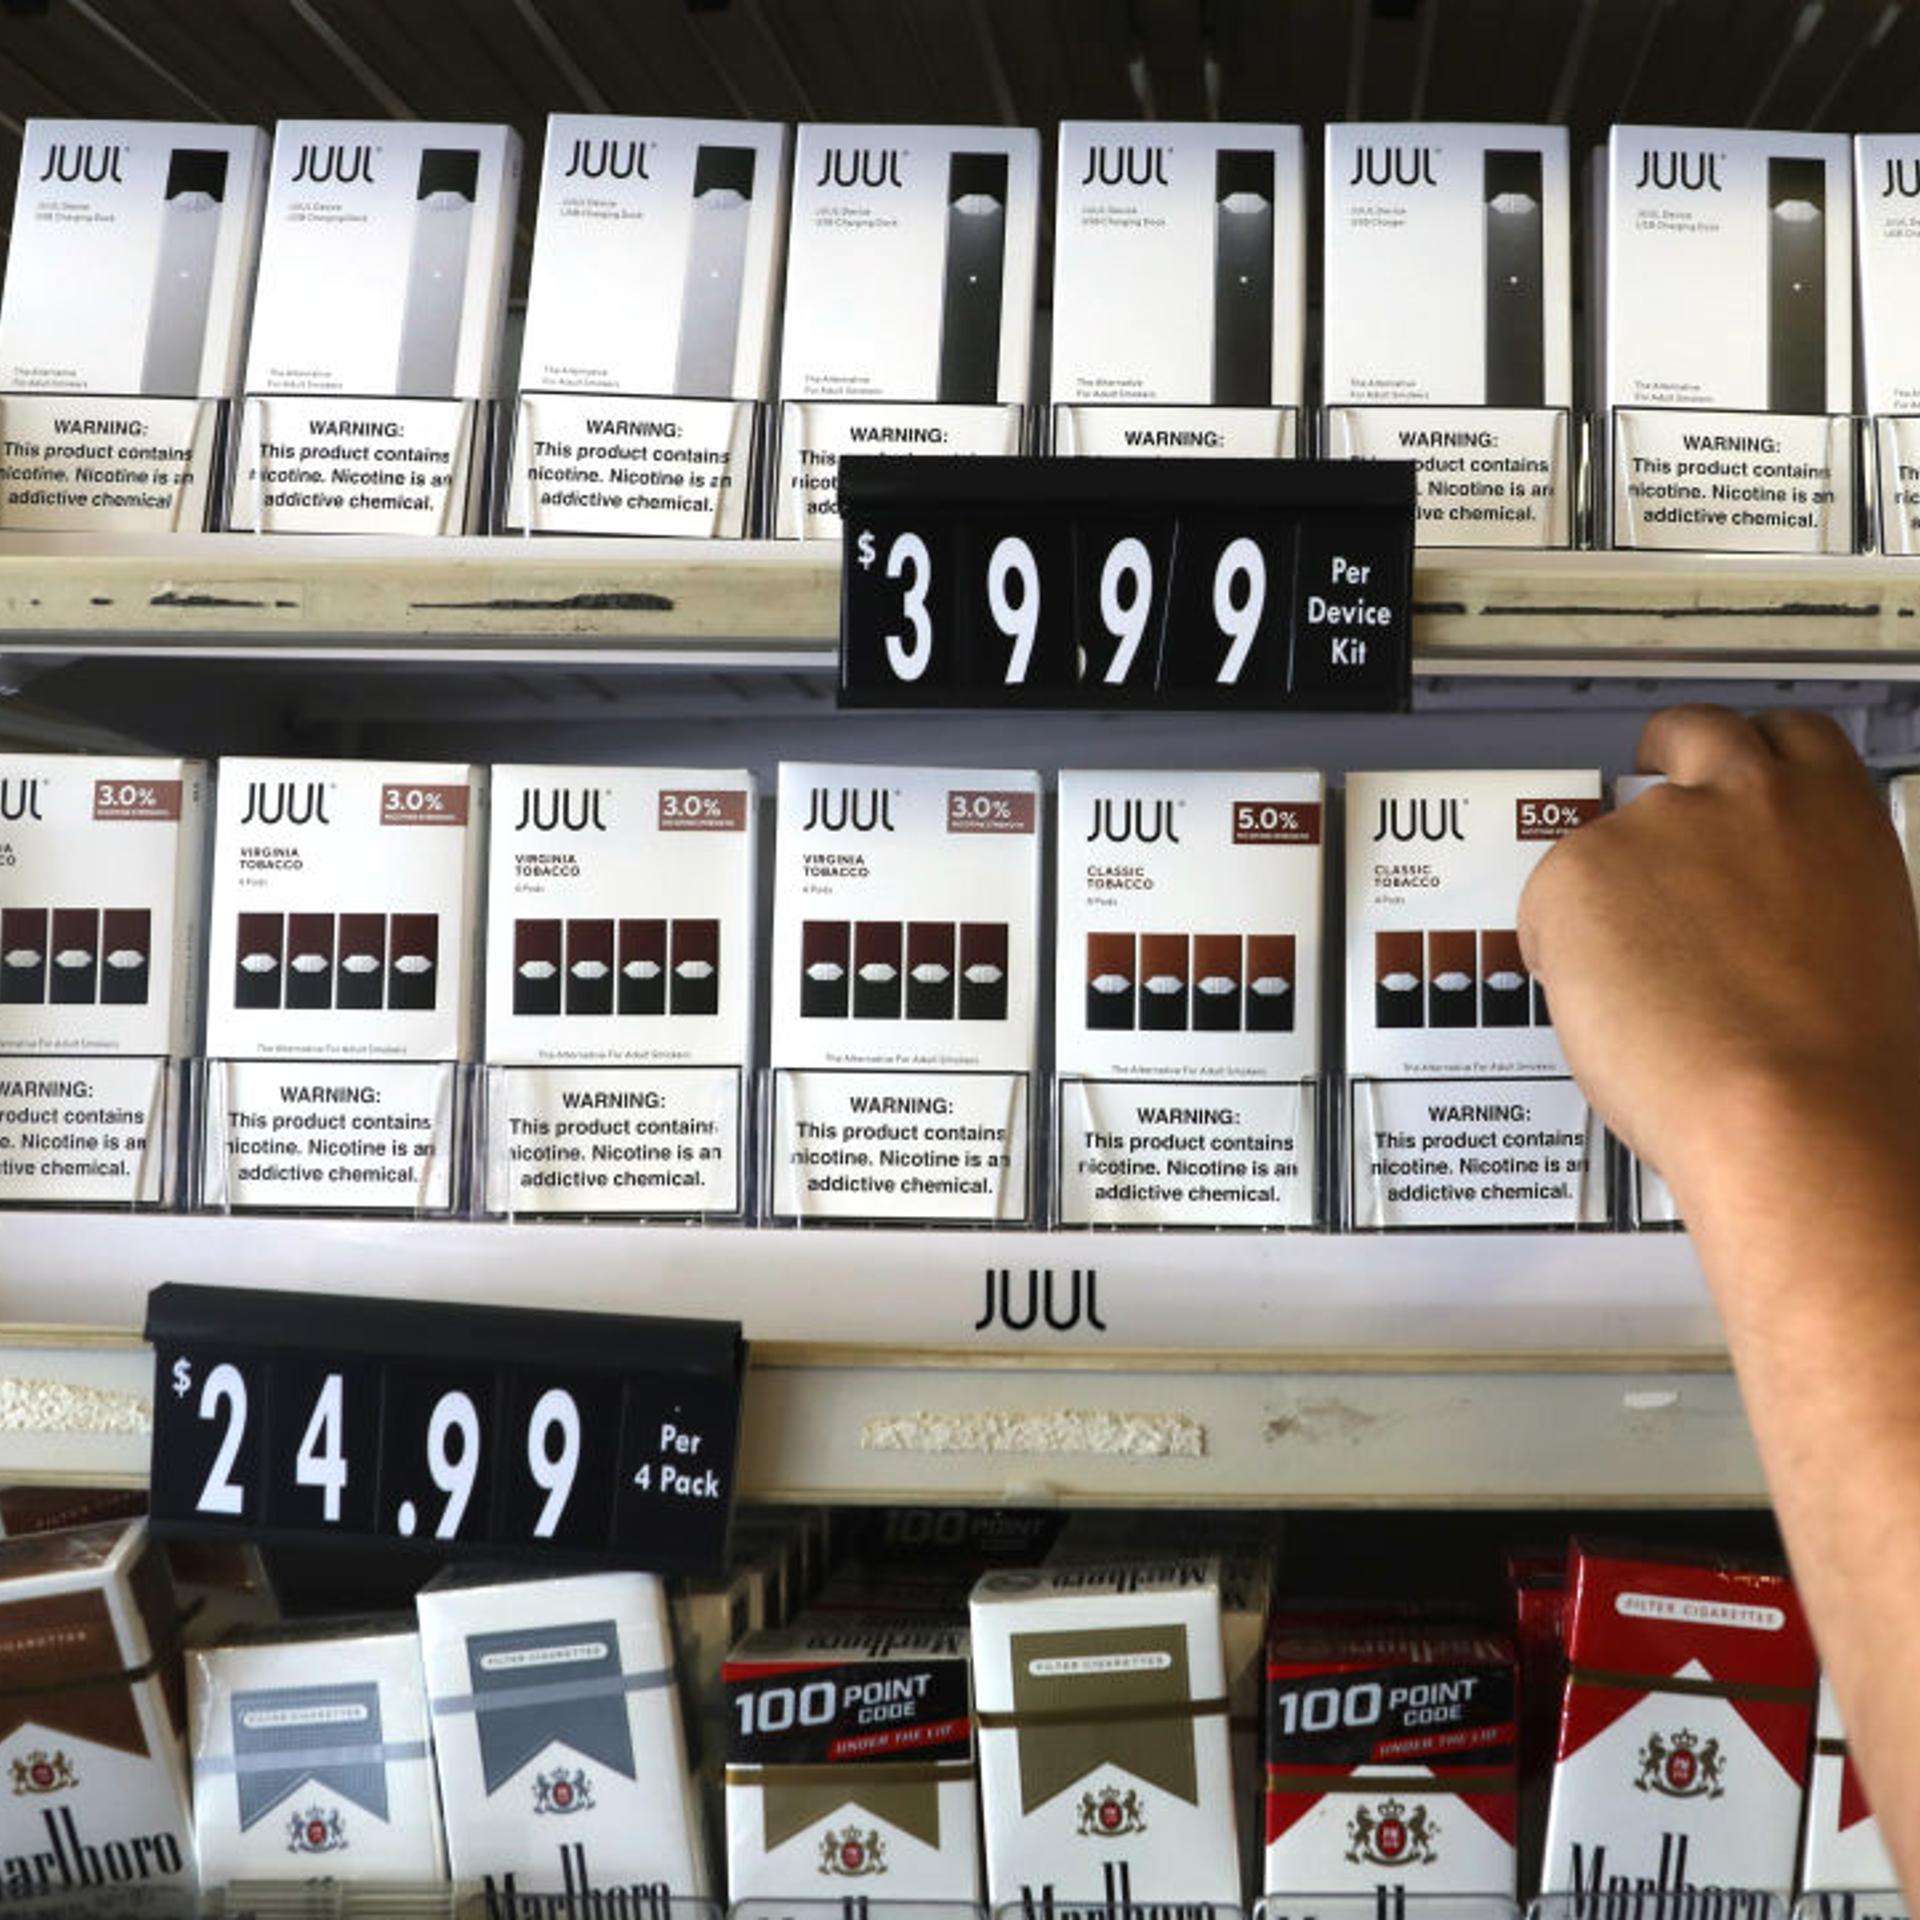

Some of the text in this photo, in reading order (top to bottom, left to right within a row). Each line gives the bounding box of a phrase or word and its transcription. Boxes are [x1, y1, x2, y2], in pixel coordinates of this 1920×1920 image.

[40, 145, 122, 182] JUUL
[292, 145, 374, 183] JUUL
[565, 141, 650, 180] JUUL
[817, 149, 902, 187] JUUL
[1082, 147, 1168, 186] JUUL
[1350, 147, 1437, 186] JUUL
[1636, 151, 1722, 192] JUUL
[1883, 159, 1920, 197] JU
[54, 419, 149, 437] WARNING:
[309, 420, 404, 437] WARNING:
[587, 420, 683, 438] WARNING:
[850, 427, 948, 443] WARNING:
[1124, 431, 1224, 448] WARNING:
[1400, 431, 1499, 448] WARNING:
[1684, 435, 1781, 453] WARNING:
[4, 442, 193, 461] This product contains
[260, 443, 450, 463] This product contains
[534, 441, 731, 464] This product contains
[801, 451, 837, 466] This
[1471, 457, 1549, 472] contains
[1633, 457, 1831, 480] This product contains
[76, 468, 168, 484] Nicotine is
[331, 468, 425, 486] Nicotine is
[528, 467, 704, 487] nicotine. Nicotine is
[1428, 481, 1525, 496] Nicotine is
[1628, 484, 1834, 504] nicotine. Nicotine is an
[9, 490, 87, 507] addictive
[264, 492, 434, 511] addictive chemical.
[541, 491, 713, 512] addictive chemical.
[1450, 505, 1536, 521] chemical.
[1644, 507, 1818, 528] addictive chemical.
[1331, 557, 1370, 585] Per
[1308, 597, 1391, 627] Device
[1331, 638, 1366, 666] Kit
[0, 778, 42, 820] UL
[99, 785, 157, 806] 3.0%
[240, 782, 330, 824] JUUL
[385, 789, 443, 810] 3.0%
[515, 788, 606, 831] JUUL
[663, 796, 721, 817] 3.0%
[804, 788, 895, 832] JUUL
[952, 796, 1011, 818] 3.0%
[1521, 804, 1579, 826] 5.0%
[1087, 799, 1179, 844] JUUL
[1239, 808, 1298, 829] 5.0%
[1374, 798, 1466, 842] JUUL
[240, 846, 299, 858] VIRGINIA
[515, 854, 577, 864] VIRGINIA
[803, 853, 864, 866] VIRGINIA
[239, 859, 303, 870] TOBACCO
[515, 865, 581, 877] TOBACCO
[803, 866, 870, 879] TOBACCO
[1087, 866, 1144, 877] CLASSIC
[1374, 865, 1432, 876] CLASSIC
[1087, 878, 1154, 890] TOBACCO
[1374, 877, 1441, 888] TOBACCO
[280, 1086, 380, 1103] WARNING:
[563, 1091, 665, 1108] WARNING:
[850, 1096, 954, 1114] WARNING:
[1429, 1105, 1531, 1122] WARNING:
[64, 1108, 144, 1124] contains
[228, 1112, 431, 1131] This product contains
[1137, 1107, 1240, 1125] WARNING:
[509, 1118, 630, 1137] This product
[797, 1122, 1006, 1142] This product contains
[22, 1133, 147, 1150] Nicotine is an
[308, 1138, 435, 1156] Nicotine is an
[1085, 1131, 1294, 1152] This product contains
[1376, 1129, 1583, 1151] This product contains
[592, 1144, 721, 1161] Nicotine is an
[880, 1150, 960, 1167] Nicotine
[965, 1151, 982, 1167] is
[41, 1158, 130, 1176] chemical.
[238, 1164, 418, 1183] addictive chemical.
[1167, 1159, 1298, 1176] Nicotine is an
[1371, 1156, 1589, 1175] nicotine. Nicotine is an
[521, 1171, 705, 1188] addictive chemical.
[807, 1175, 993, 1194] addictive chemical.
[1095, 1183, 1280, 1202] addictive chemical.
[1388, 1182, 1573, 1202] addictive chemical.
[975, 1269, 1106, 1331] JUUL
[661, 1423, 700, 1454] Per
[634, 1468, 719, 1498] 4 Pack
[736, 1674, 932, 1735] 100 POINT
[859, 1701, 915, 1724] CODE
[1279, 1677, 1478, 1735] 100 POINT
[1403, 1704, 1462, 1727] CODE
[0, 1805, 183, 1900] arlboro
